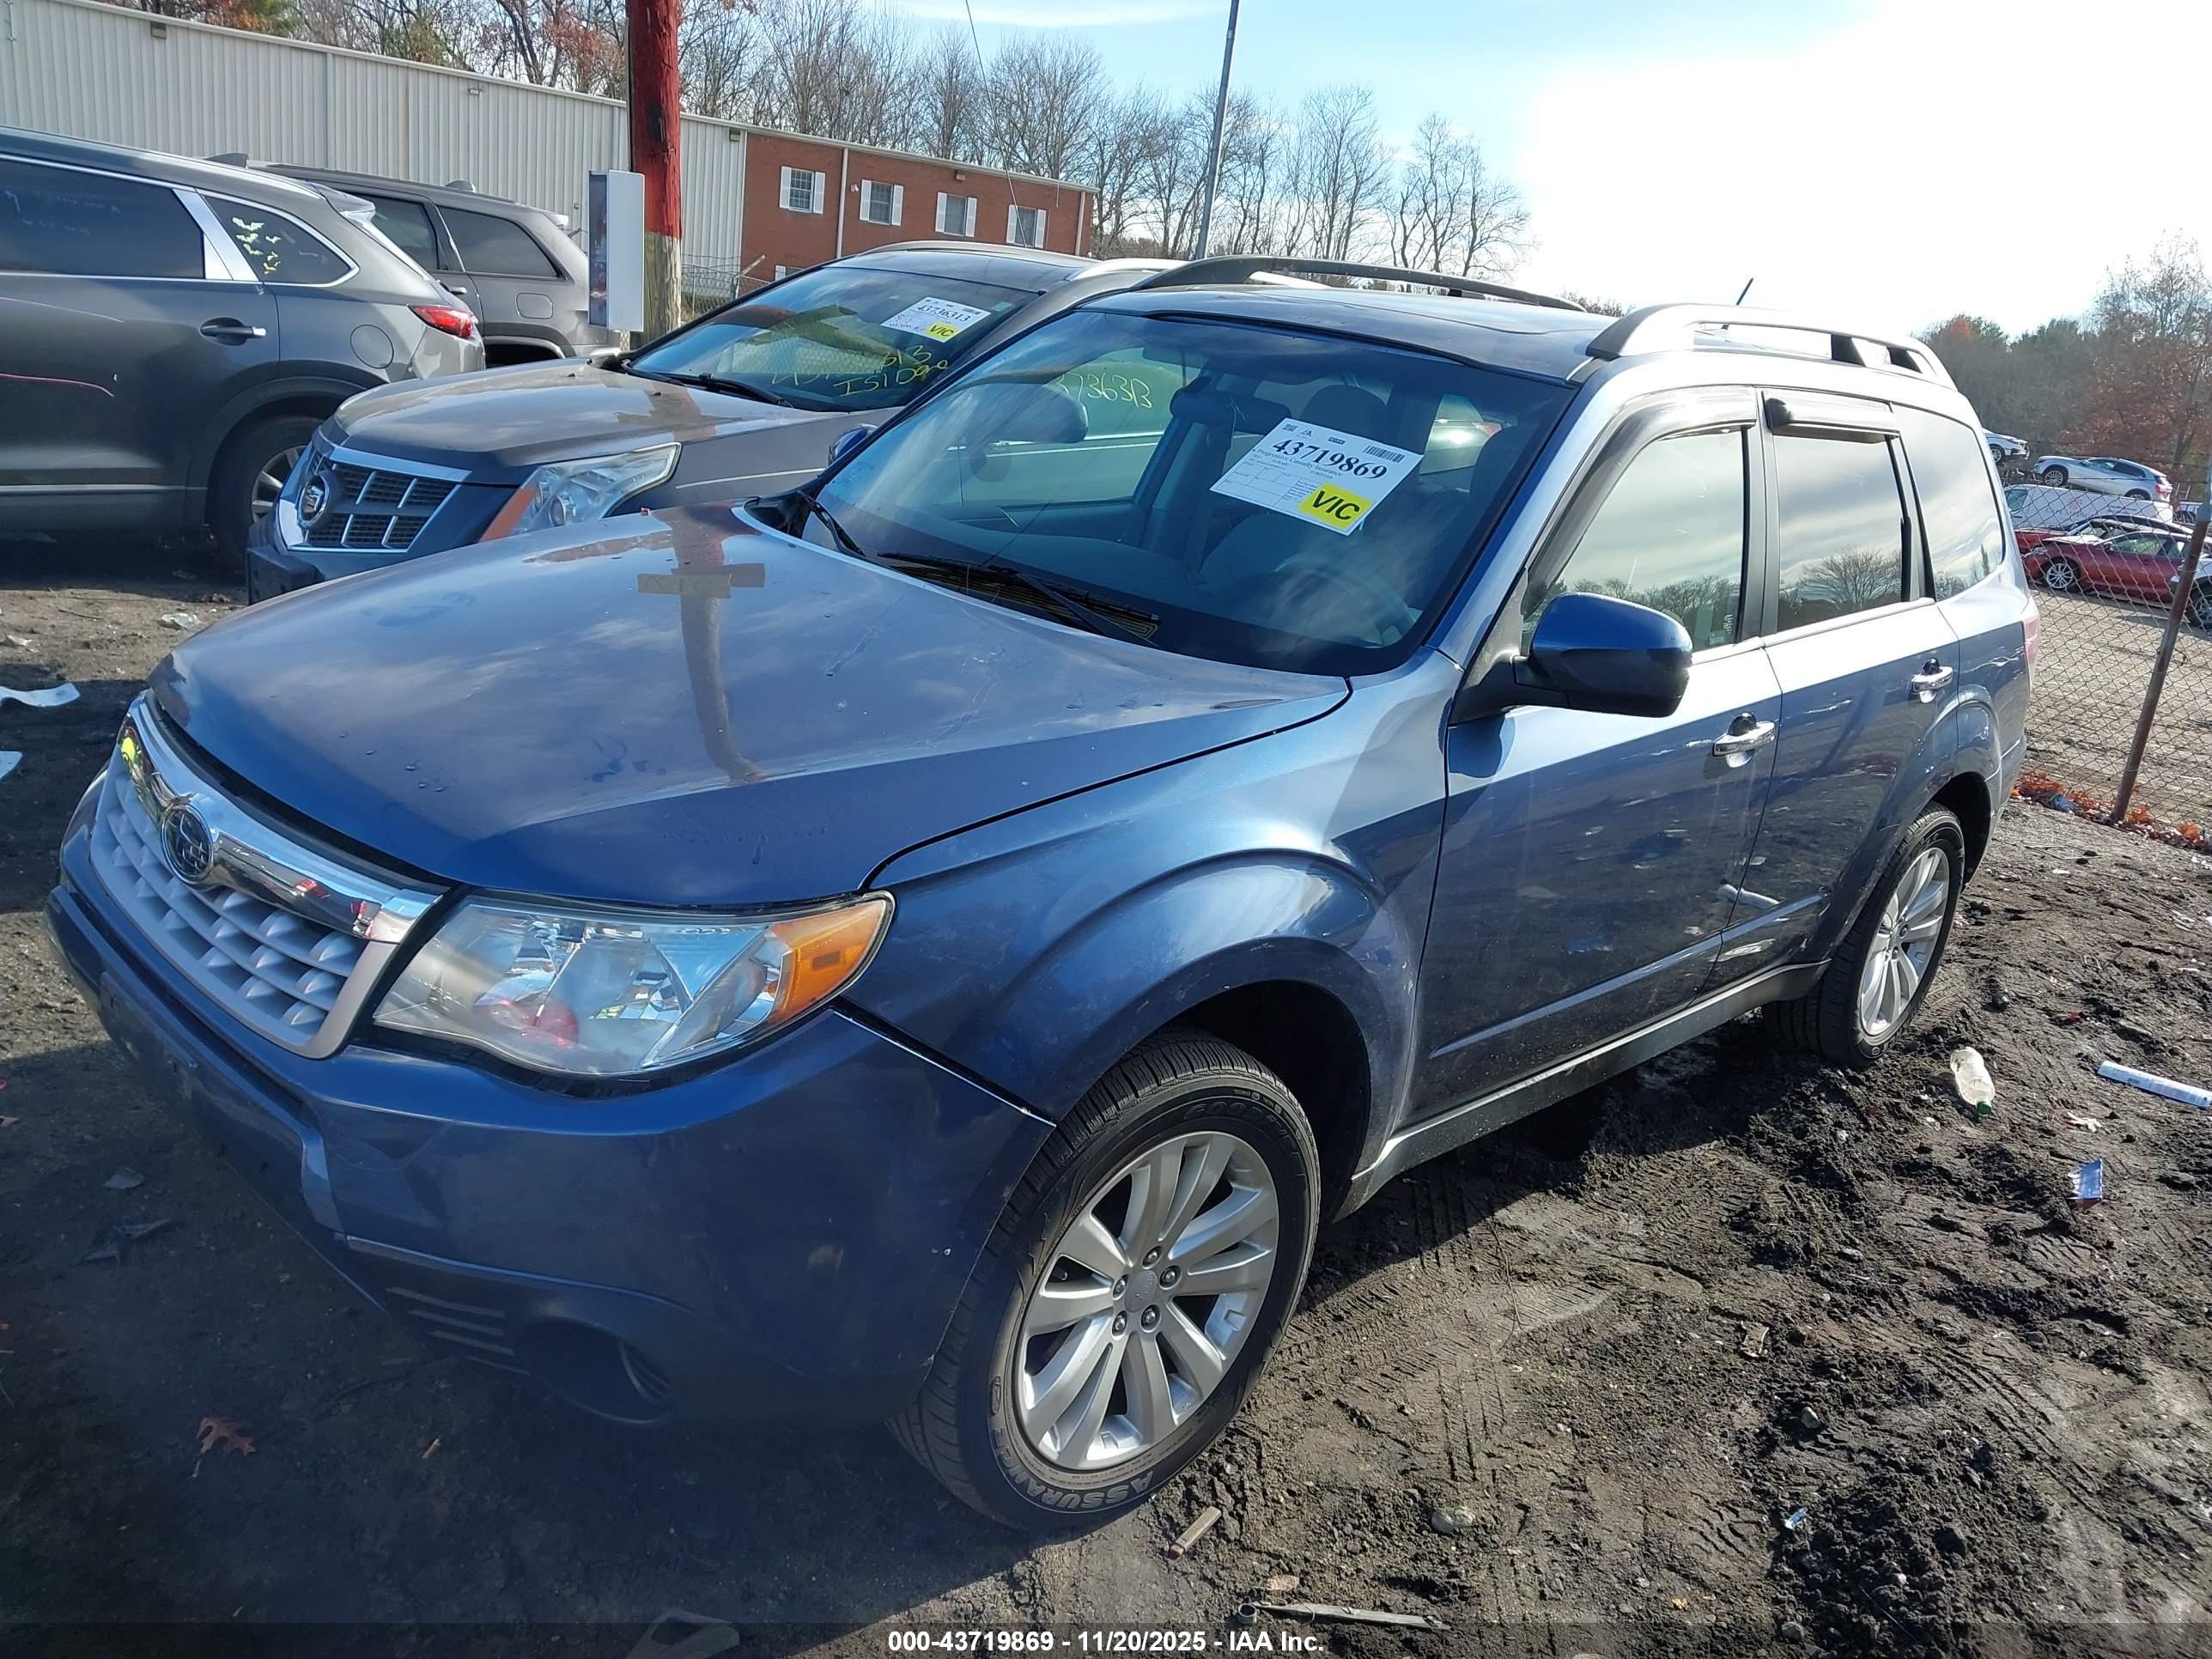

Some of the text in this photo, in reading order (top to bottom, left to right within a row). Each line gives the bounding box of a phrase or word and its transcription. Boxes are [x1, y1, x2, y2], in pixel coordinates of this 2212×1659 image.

[917, 305, 971, 322] 43736313
[930, 325, 955, 337] VIC
[1257, 448, 1290, 461] Progressive
[1290, 458, 1315, 469] Casualty
[1314, 465, 1343, 477] Insurance
[1272, 439, 1388, 479] 43719869
[1312, 489, 1360, 520] VIC
